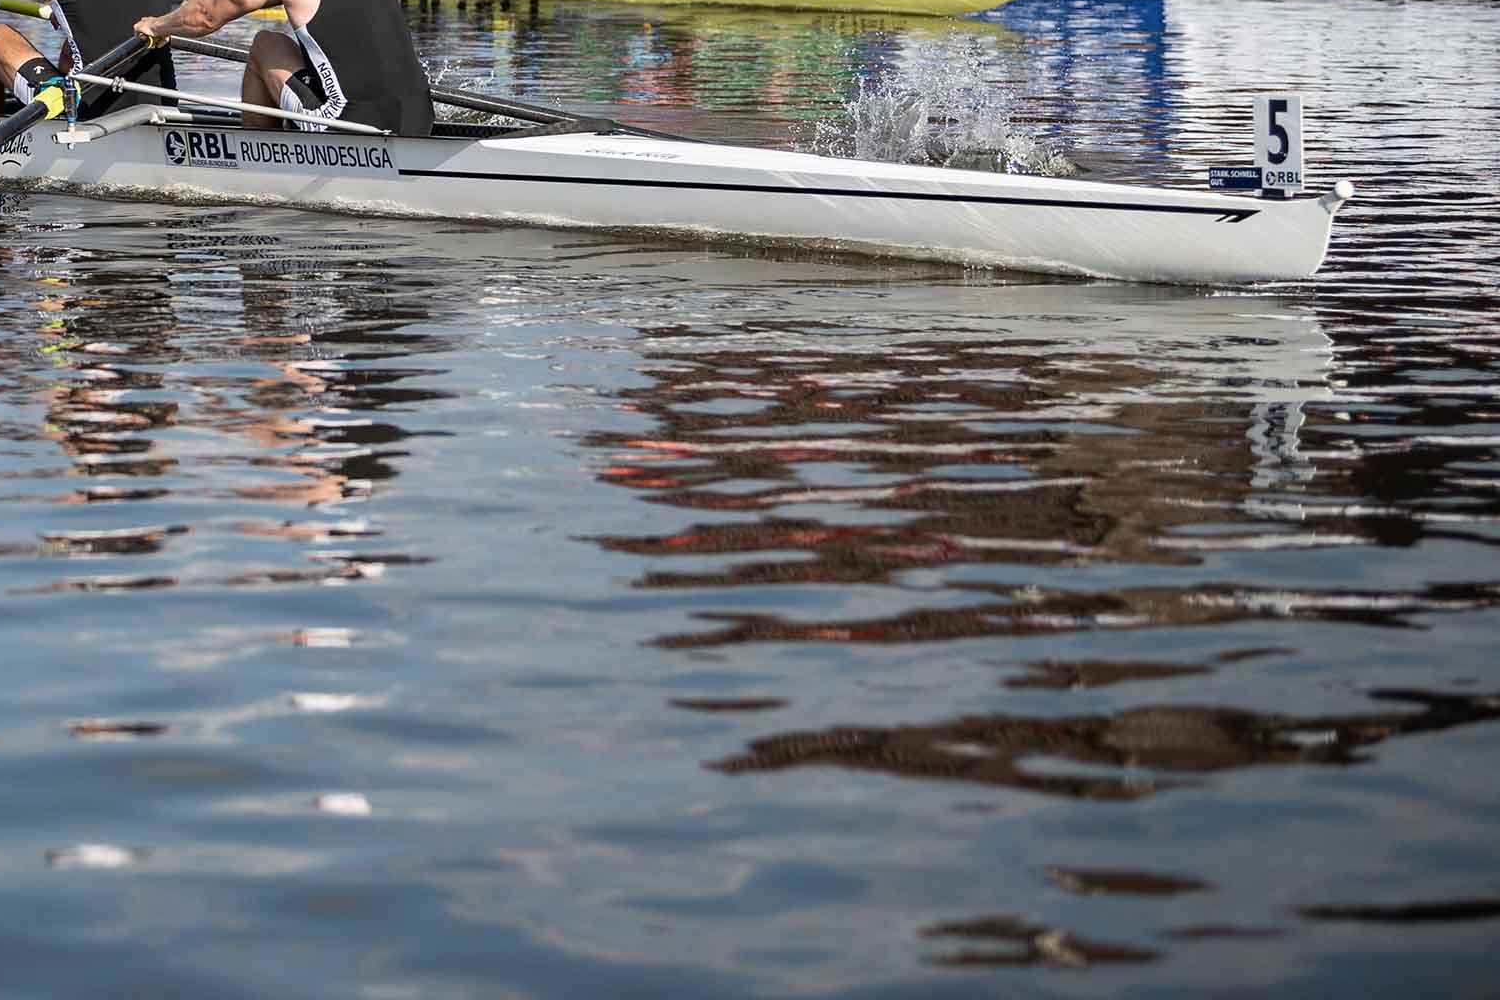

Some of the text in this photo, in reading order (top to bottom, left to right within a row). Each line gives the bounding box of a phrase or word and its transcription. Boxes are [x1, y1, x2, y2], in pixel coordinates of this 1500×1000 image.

[190, 132, 394, 169] RBL RUDER-BUNDESLIGA
[1267, 99, 1289, 165] 5
[1278, 171, 1301, 183] RBL
